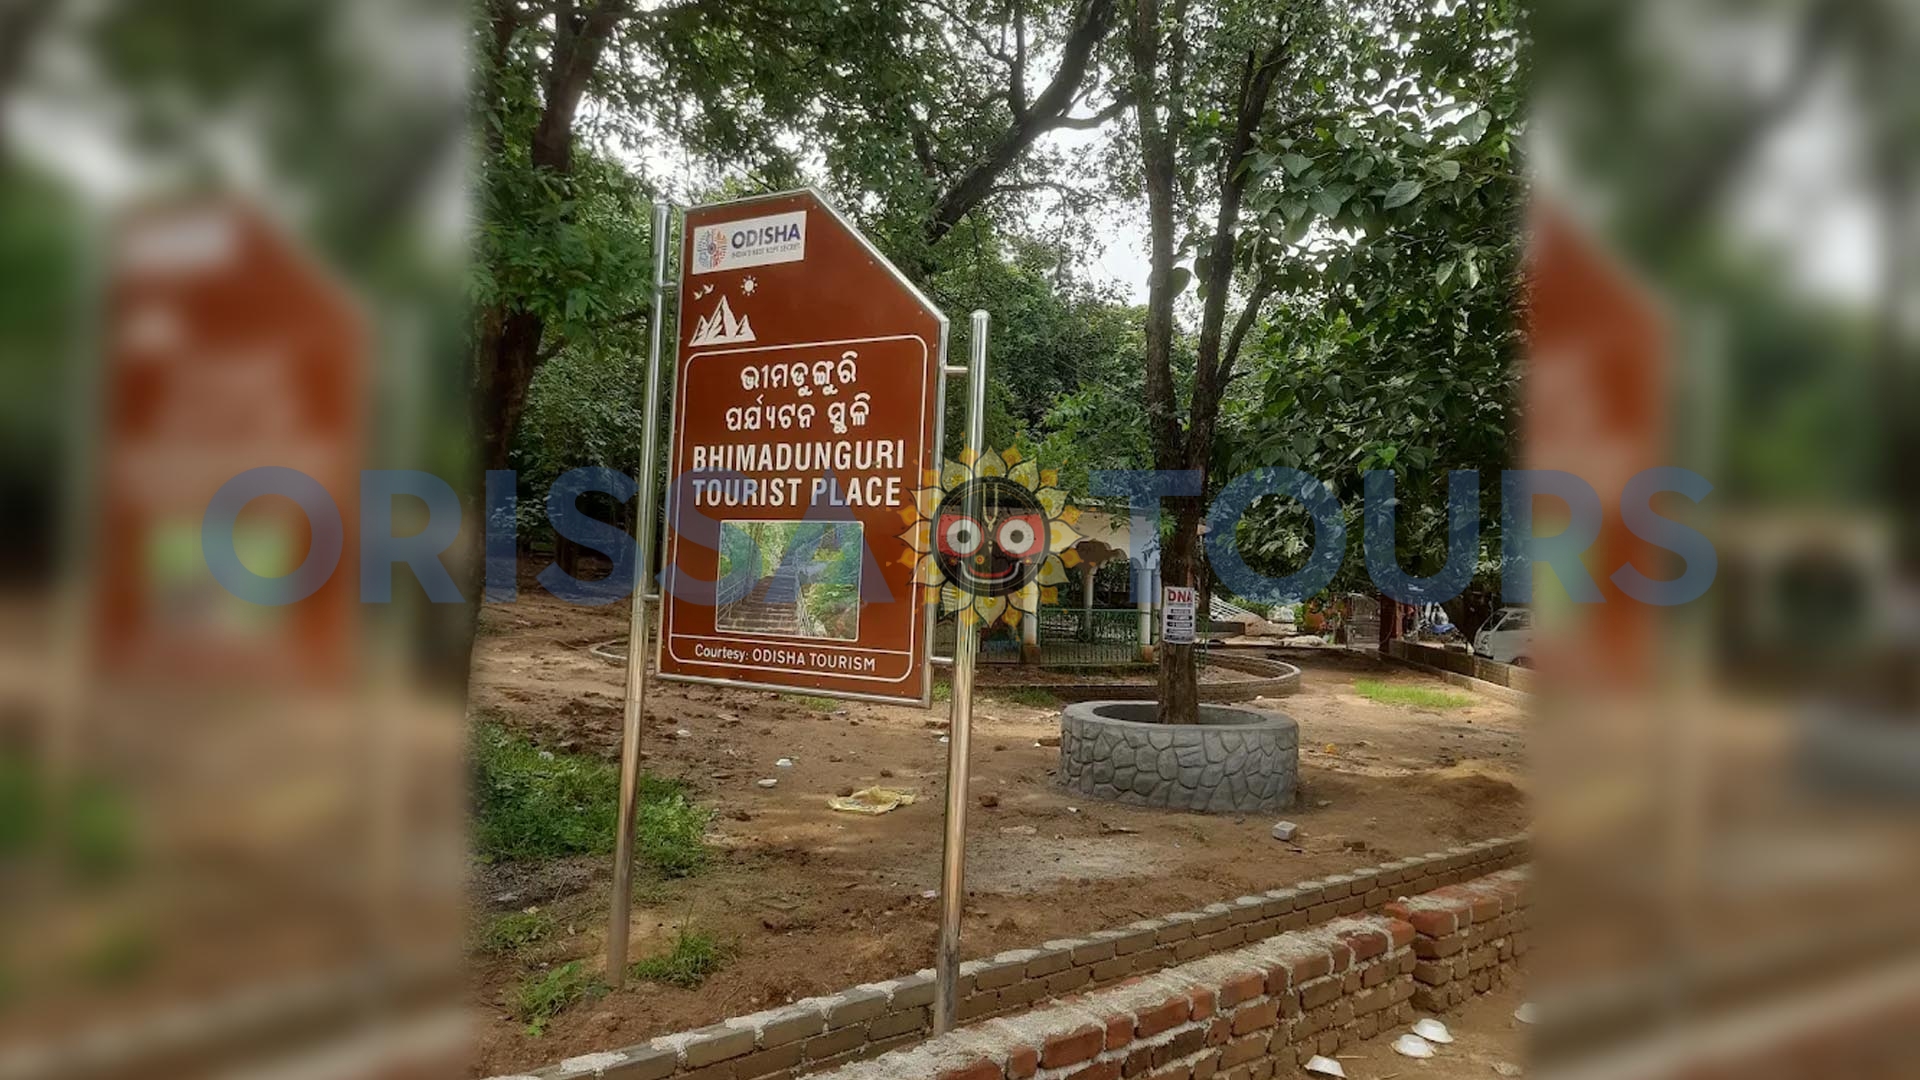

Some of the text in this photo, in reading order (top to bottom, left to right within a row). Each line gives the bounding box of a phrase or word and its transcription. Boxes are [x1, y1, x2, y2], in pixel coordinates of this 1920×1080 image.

[731, 223, 801, 249] ODISHA
[692, 439, 905, 473] BHIMADUNGURI
[692, 476, 902, 507] TOURIST PLACE
[695, 643, 876, 672] Courtesy: ODISHA TOURISM
